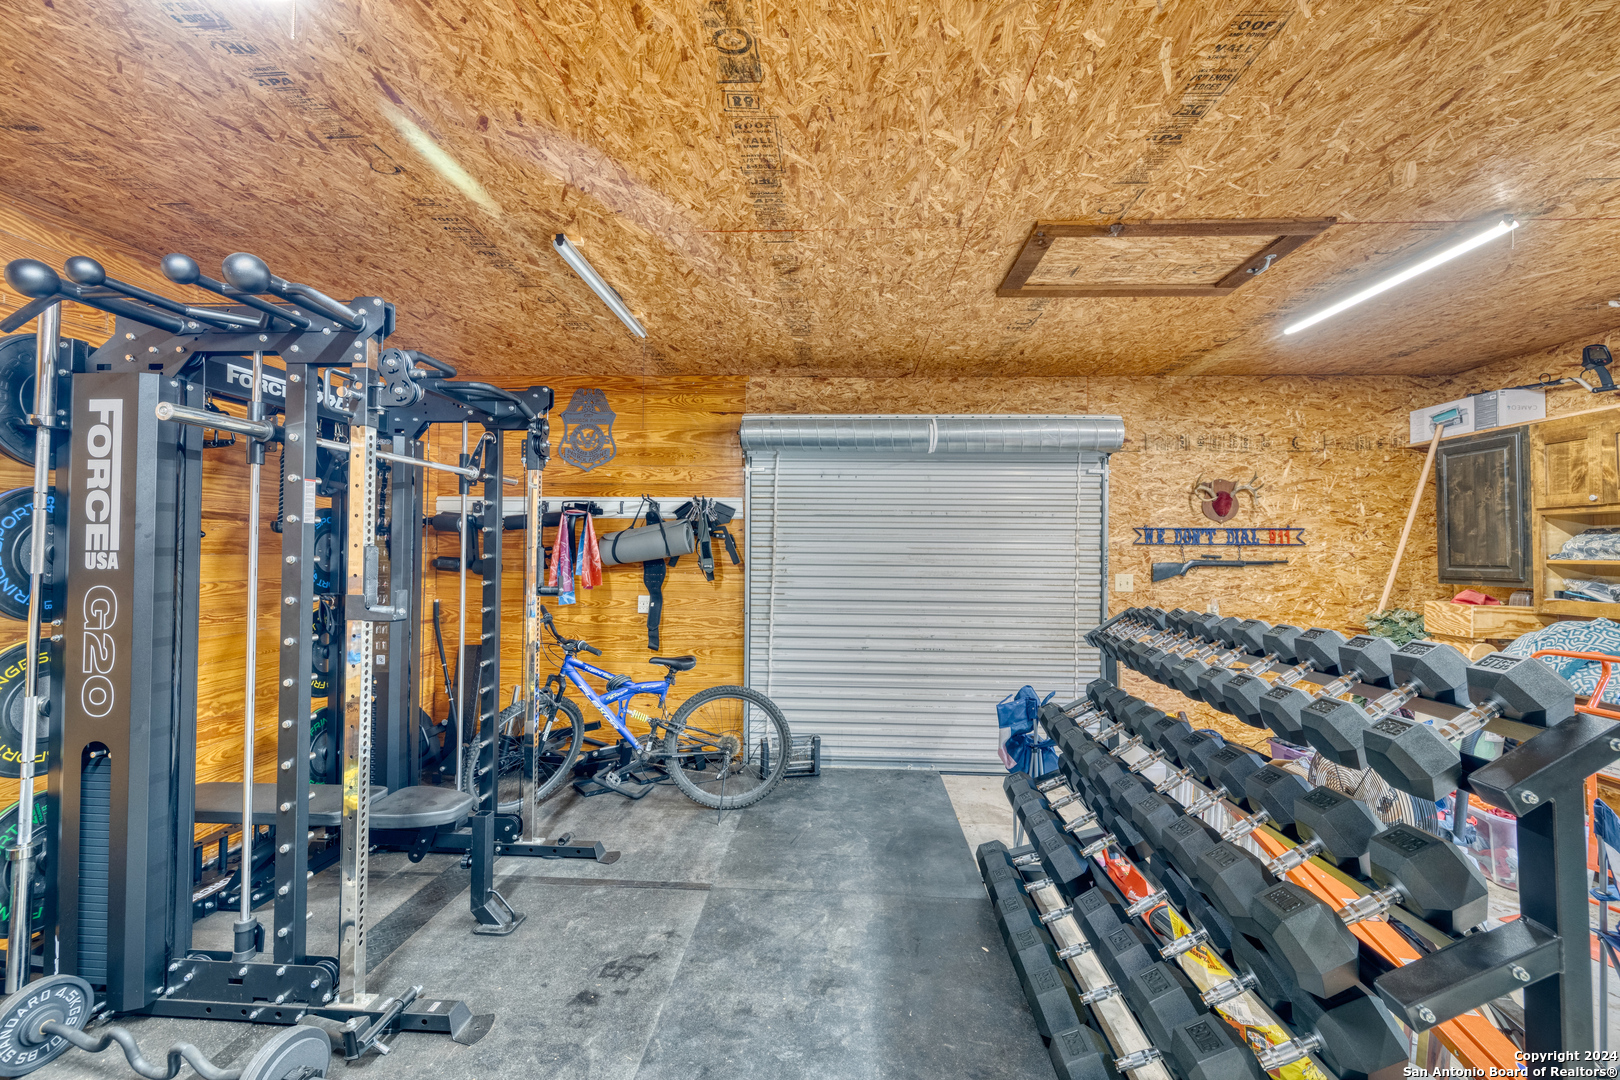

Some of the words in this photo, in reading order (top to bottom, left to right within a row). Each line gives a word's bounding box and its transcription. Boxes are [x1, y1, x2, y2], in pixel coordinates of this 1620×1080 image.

[227, 363, 286, 398] FORC
[85, 399, 124, 550] FORCE
[84, 551, 119, 570] USA
[1144, 529, 1166, 544] WE
[1174, 529, 1216, 545] DON'T
[1226, 529, 1260, 545] DIAL
[1269, 529, 1291, 545] 911
[81, 585, 118, 718] G20
[0, 989, 51, 1063] STANDARD
